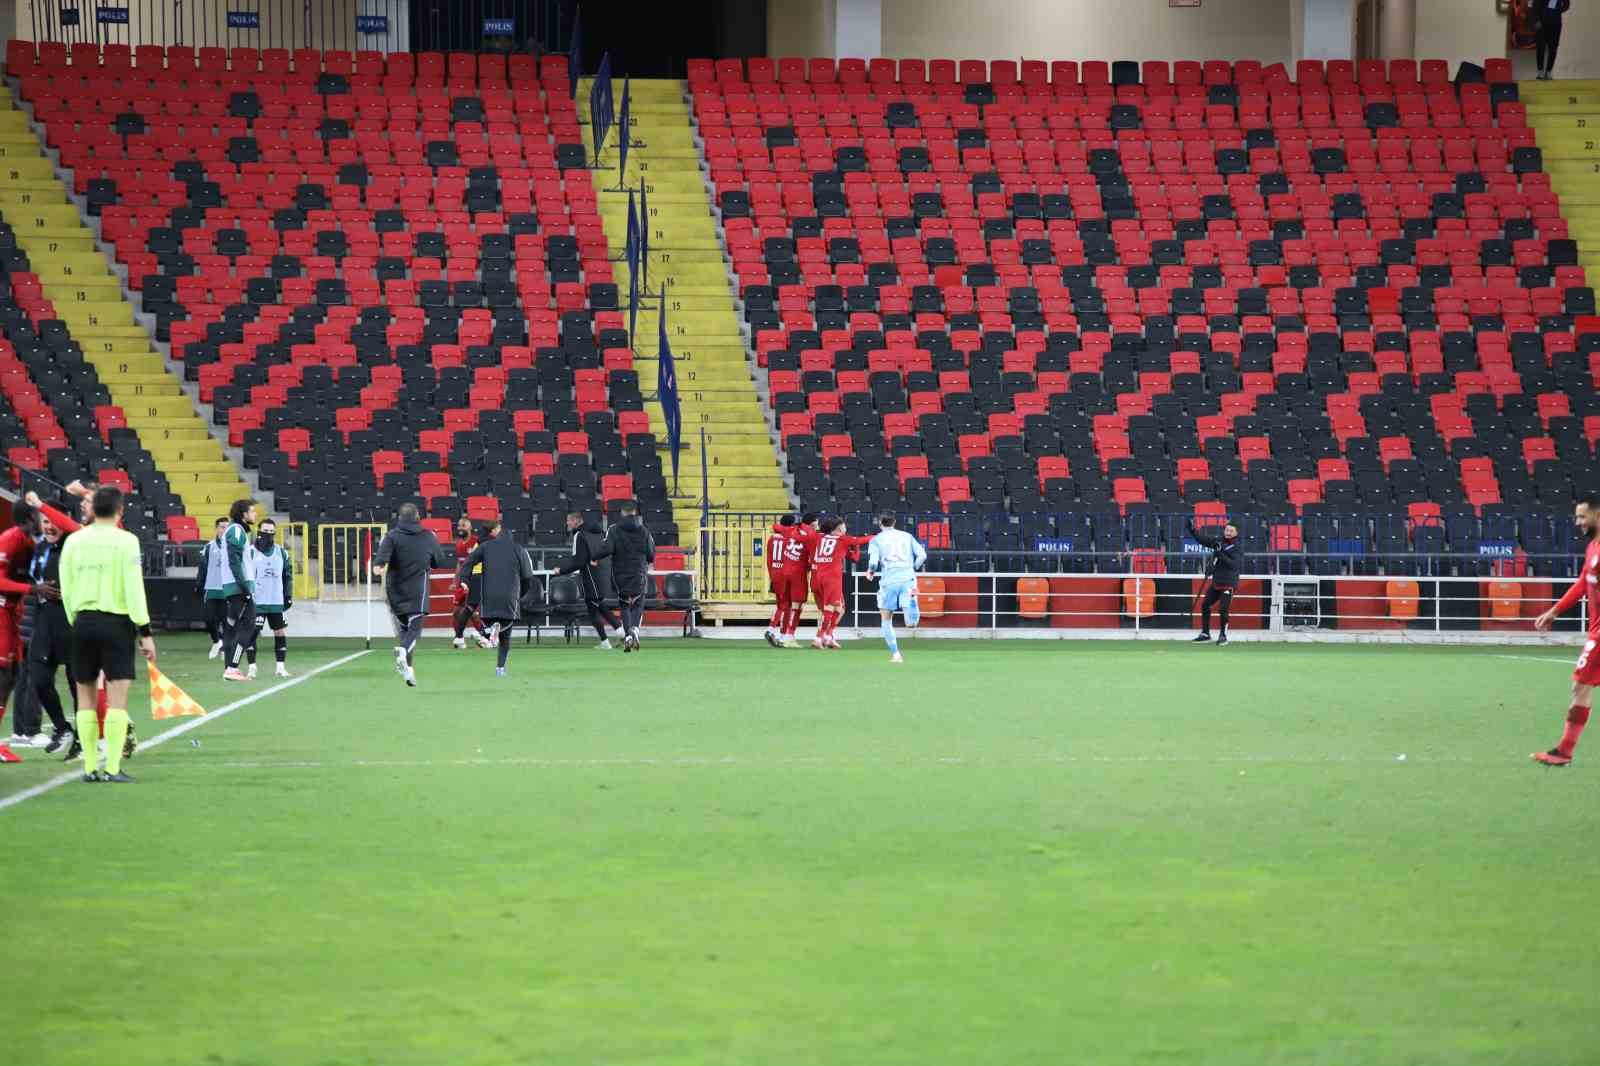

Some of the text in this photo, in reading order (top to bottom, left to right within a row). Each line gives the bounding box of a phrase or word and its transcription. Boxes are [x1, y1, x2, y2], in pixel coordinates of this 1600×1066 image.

[98, 10, 127, 20] POLIS
[229, 15, 257, 24] POLIS
[485, 23, 513, 31] POLIS
[772, 539, 784, 561] 11
[819, 538, 837, 556] 18
[1038, 543, 1071, 552] POLIS
[1480, 545, 1513, 556] POLIS
